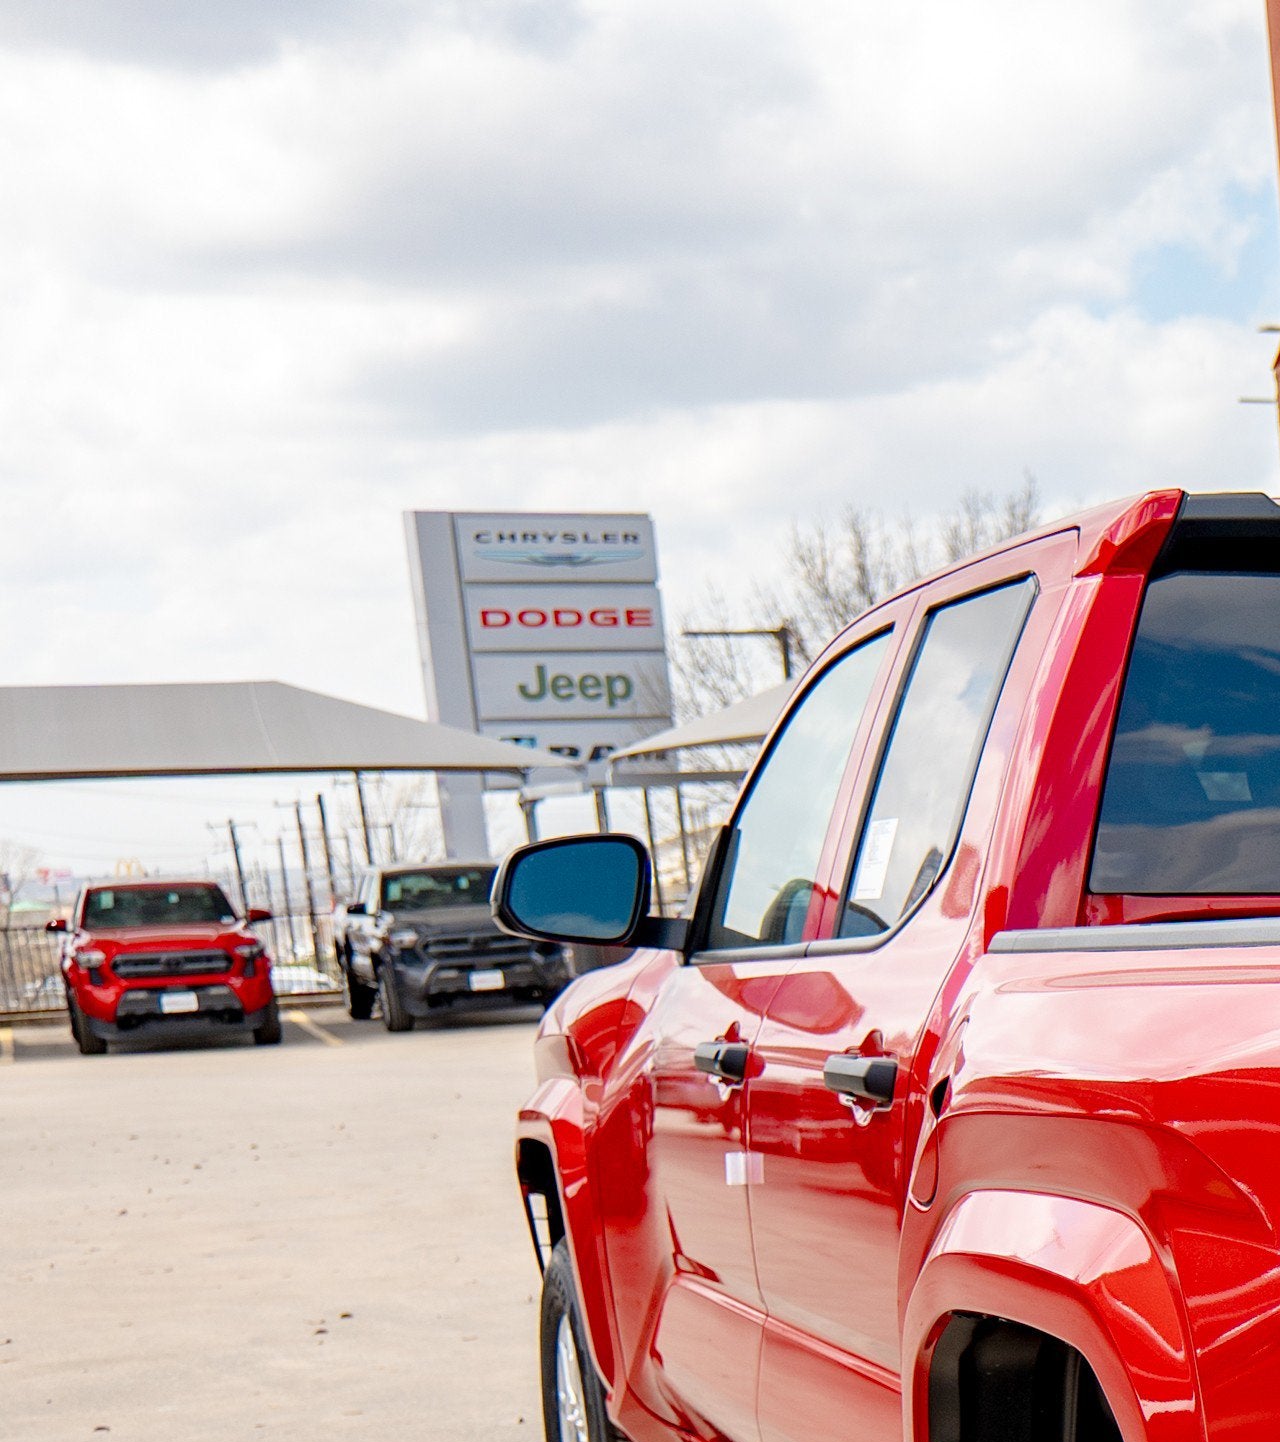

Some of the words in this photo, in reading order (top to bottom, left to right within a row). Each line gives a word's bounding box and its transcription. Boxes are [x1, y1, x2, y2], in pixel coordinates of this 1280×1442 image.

[474, 530, 641, 545] CHRYSLER
[480, 608, 655, 628] DODGE
[518, 664, 634, 708] Jeep
